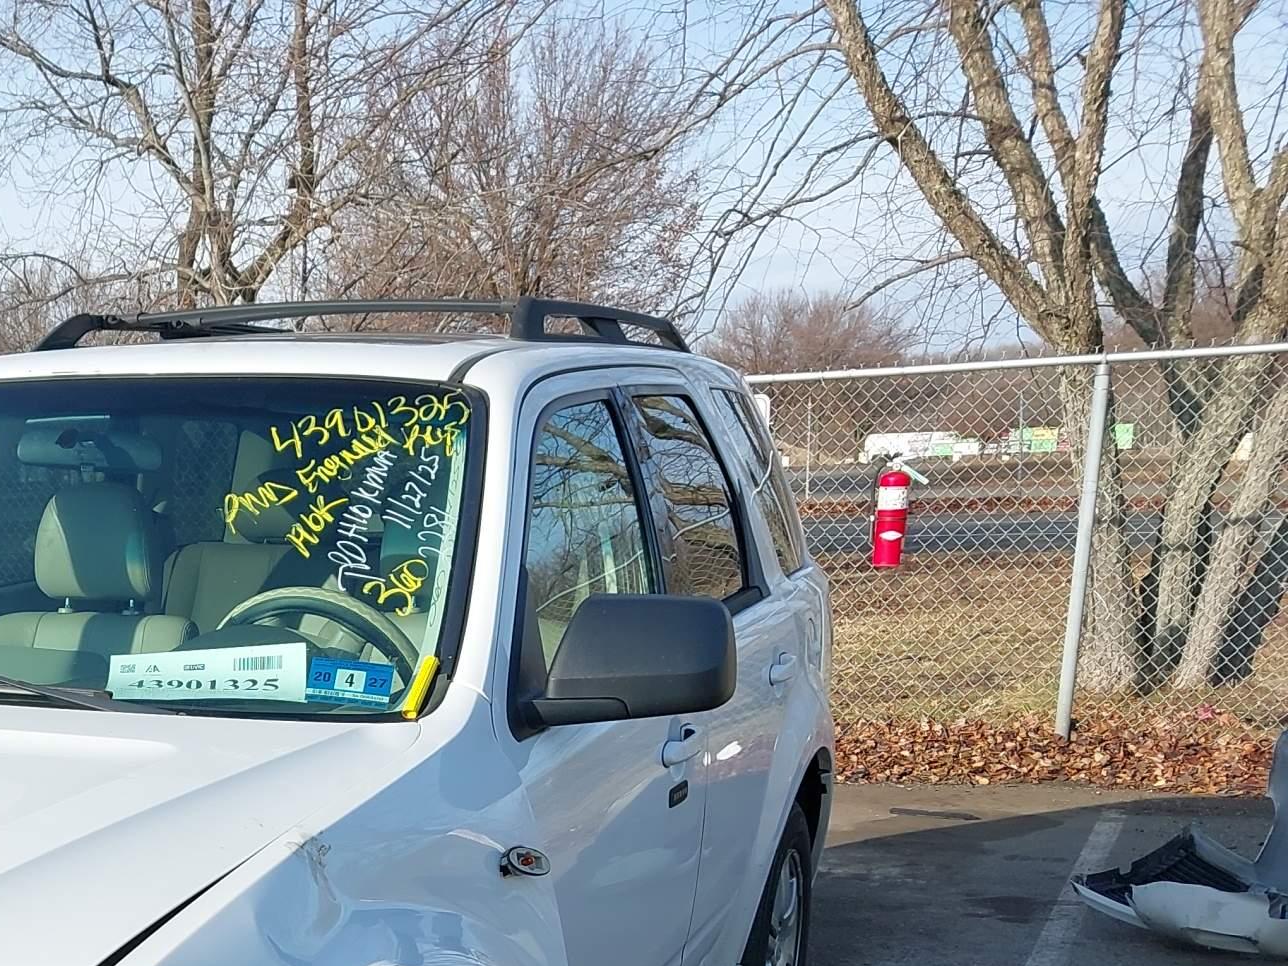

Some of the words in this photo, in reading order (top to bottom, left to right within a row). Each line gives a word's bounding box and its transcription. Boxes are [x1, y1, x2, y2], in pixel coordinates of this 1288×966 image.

[128, 678, 280, 692] 43901325
[314, 671, 332, 683] 20
[344, 673, 355, 688] 4
[367, 677, 388, 689] 27
